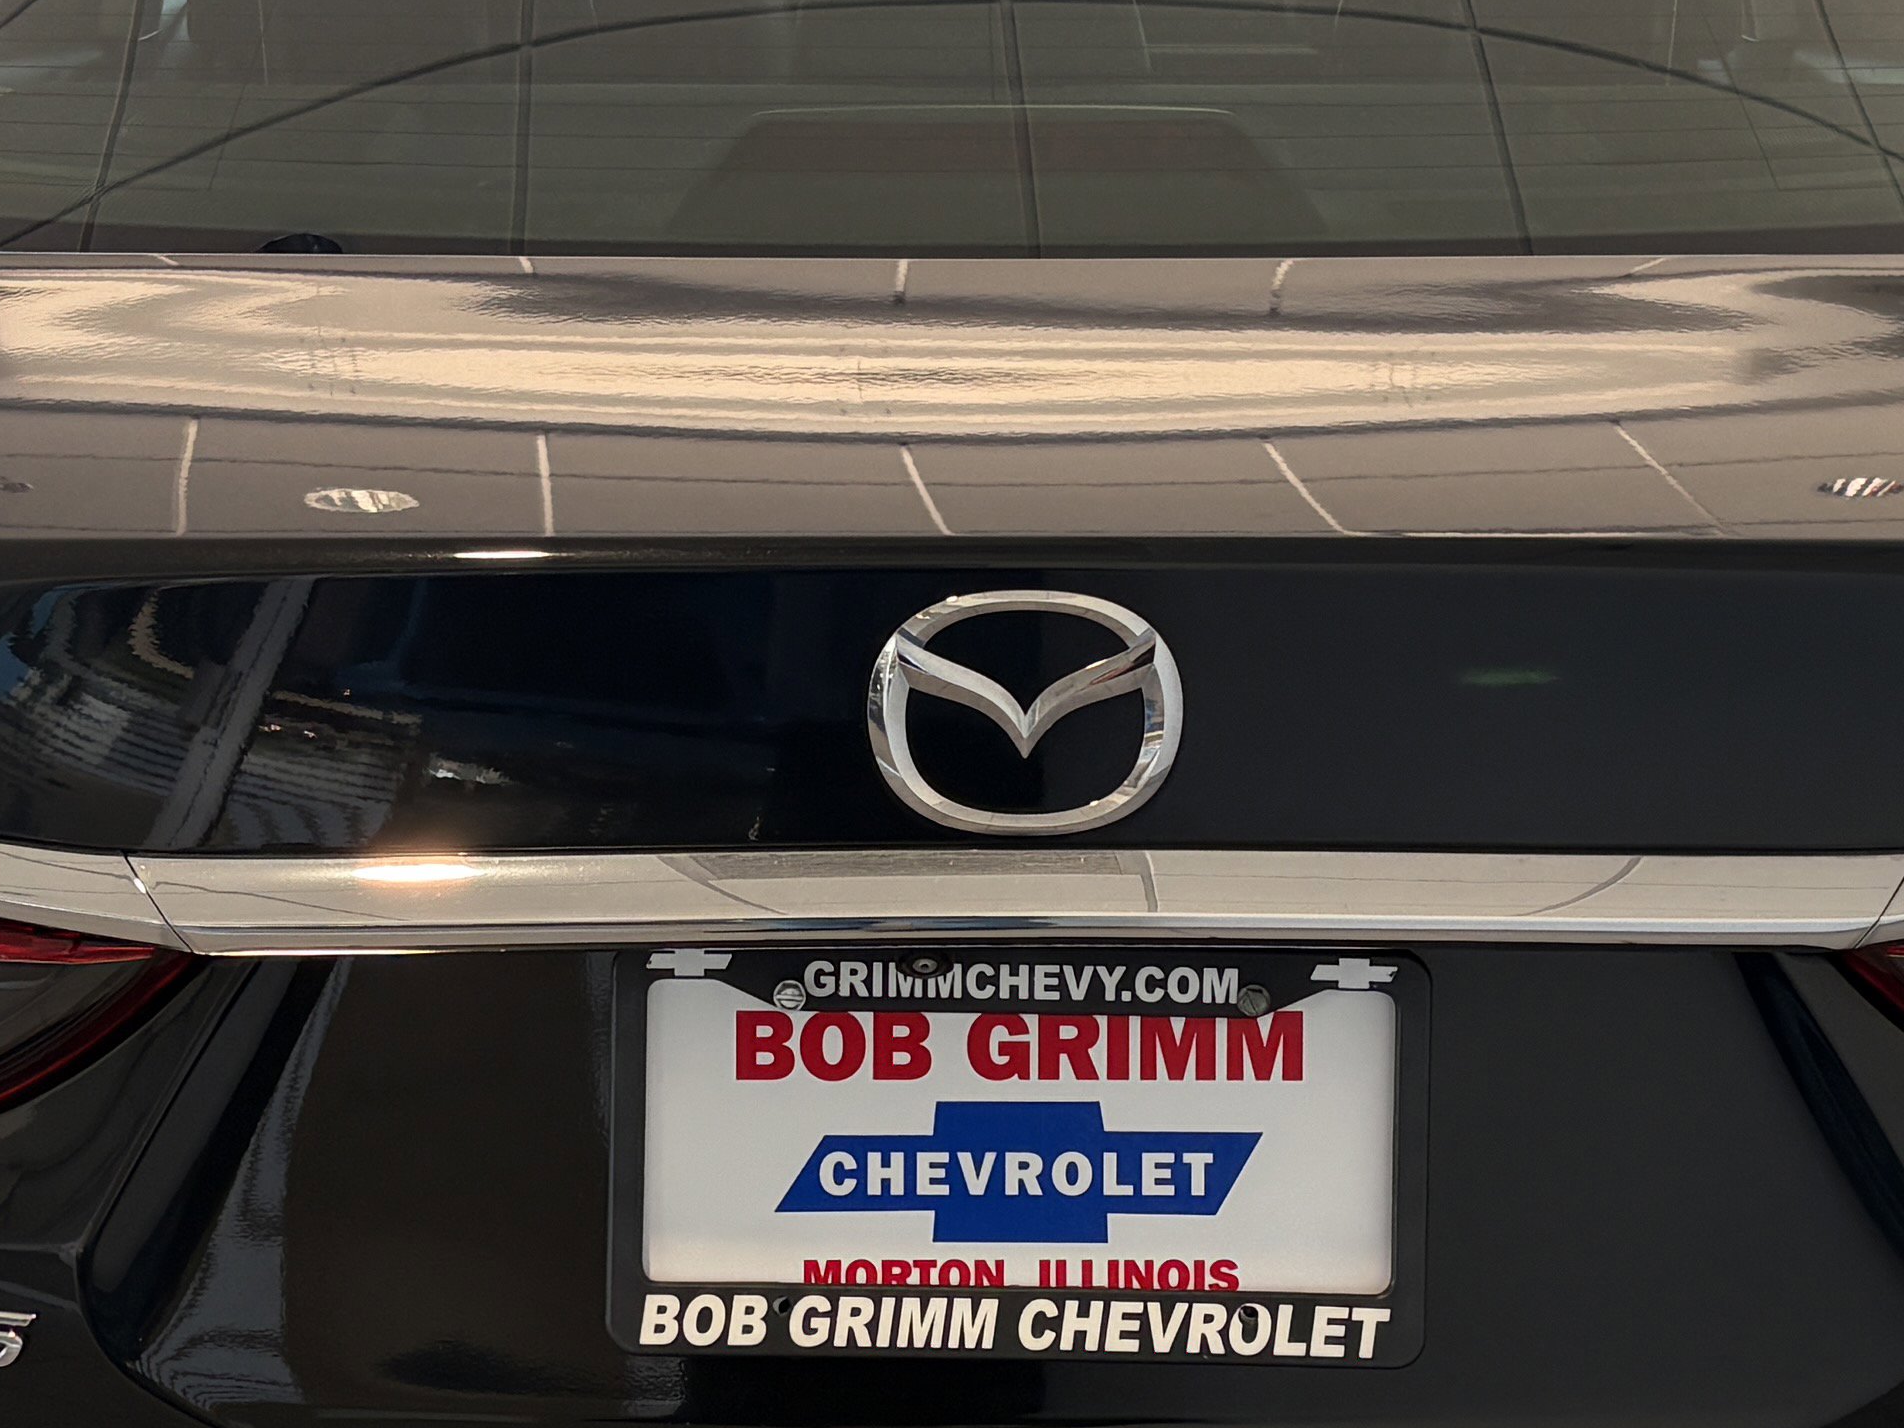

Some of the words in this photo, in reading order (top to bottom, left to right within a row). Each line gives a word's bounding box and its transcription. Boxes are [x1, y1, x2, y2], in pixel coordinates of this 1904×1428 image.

[803, 959, 1240, 1005] GRIMMCHEVY.COM
[735, 1010, 932, 1082] BOB
[966, 1010, 1304, 1082] GRIMM
[818, 1150, 1215, 1197] CHEVROLET
[802, 1258, 1006, 1288] MORTON
[639, 1293, 769, 1347] BOB
[788, 1294, 1000, 1350] GRIMM
[1017, 1298, 1392, 1360] CHEVROLET
